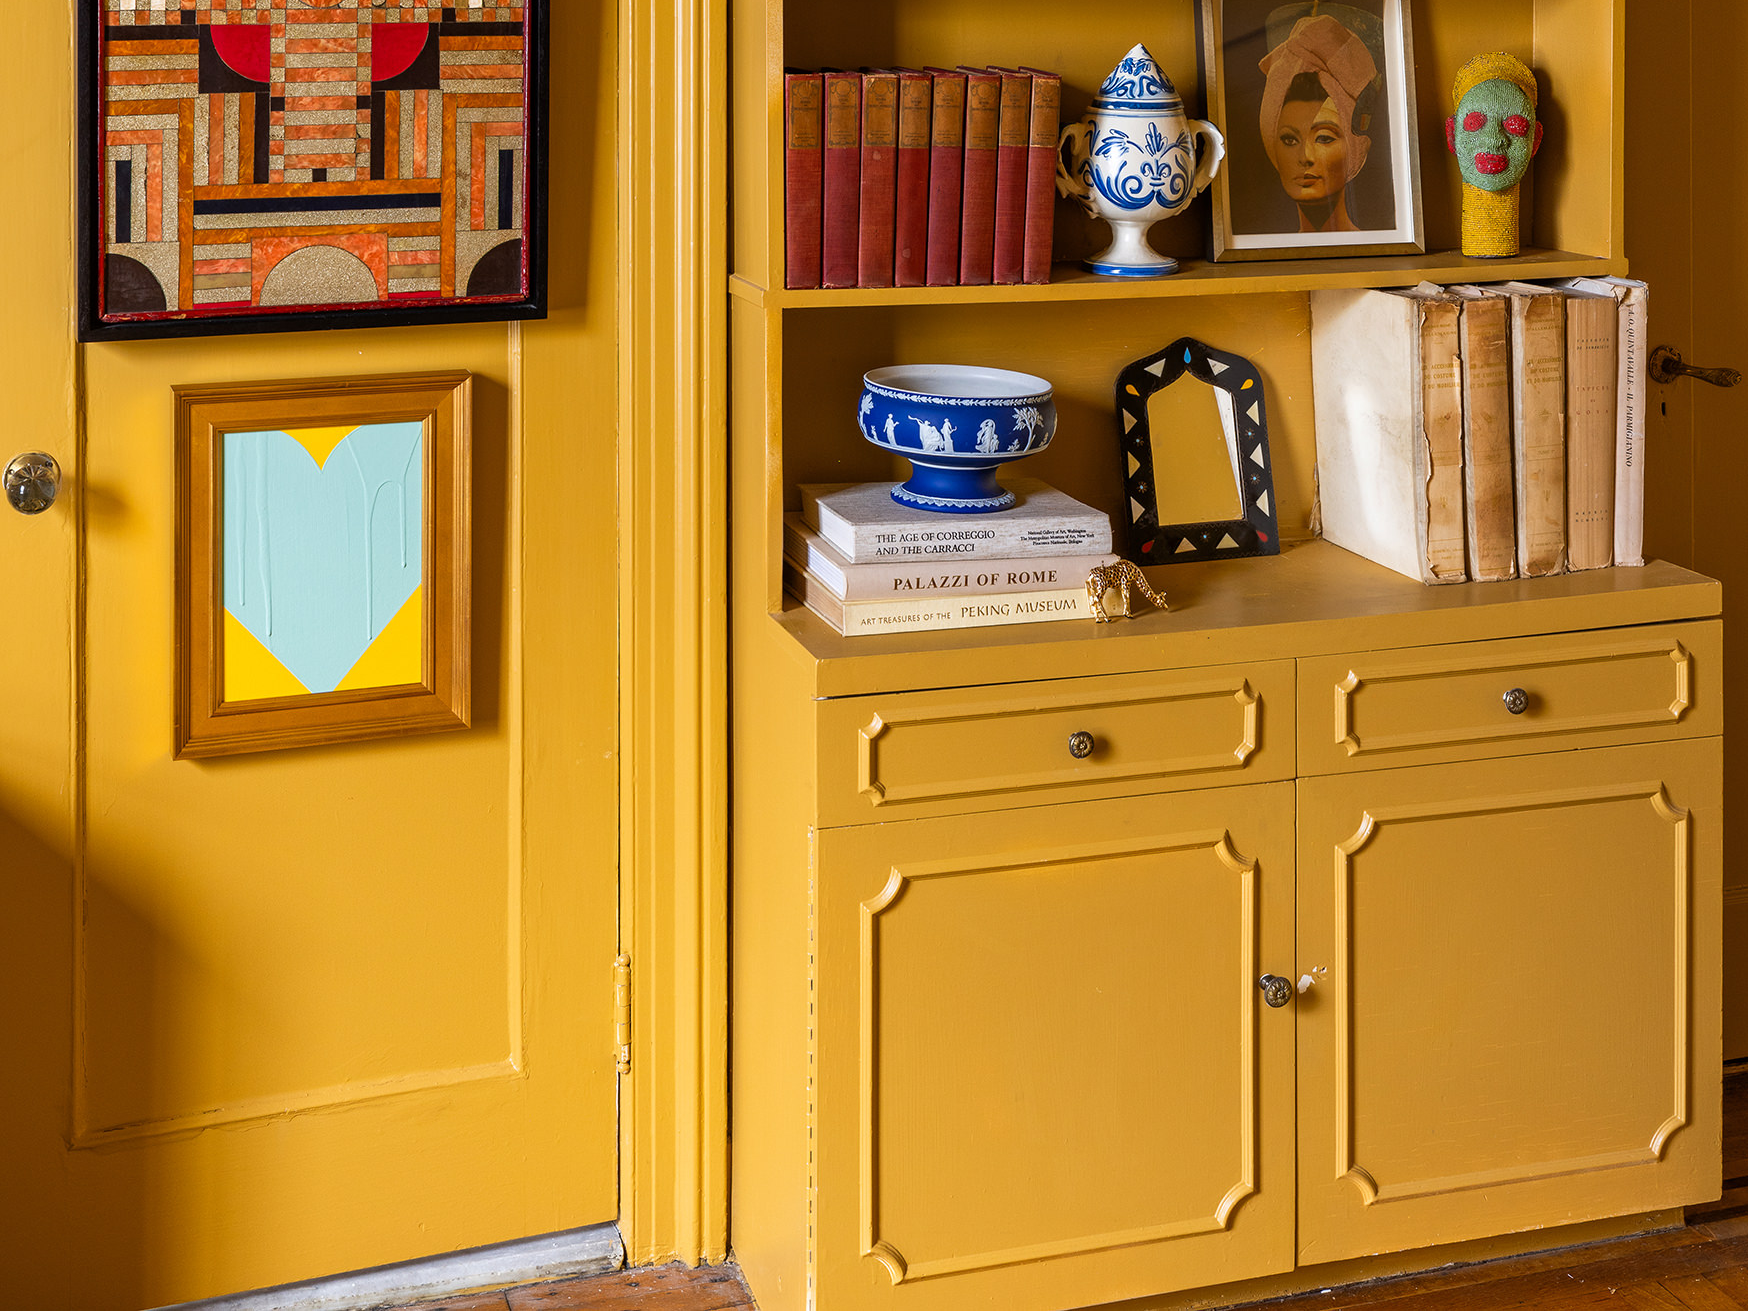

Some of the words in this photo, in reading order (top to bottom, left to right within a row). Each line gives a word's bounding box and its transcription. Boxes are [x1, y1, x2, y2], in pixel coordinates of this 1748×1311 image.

[1240, 143, 1253, 152] The
[1236, 153, 1260, 162] TIGER
[1627, 309, 1635, 318] A.
[1627, 318, 1635, 328] O.
[1626, 328, 1635, 385] QUINTAVALLE
[1626, 392, 1634, 402] IL
[1625, 405, 1634, 468] PARMIGIANINO
[876, 534, 897, 544] THE
[899, 533, 920, 543] AGE
[921, 532, 935, 542] OF
[936, 530, 996, 541] CORREGGIO
[876, 547, 899, 556] AND
[901, 546, 922, 555] THE
[924, 543, 975, 554] CARRACCI
[893, 575, 969, 591] PALAZZI
[977, 573, 1000, 587] OF
[1007, 570, 1058, 585] ROME
[861, 618, 877, 626] ART
[878, 615, 921, 624] TREASURES
[923, 613, 935, 621] OF
[937, 612, 952, 620] THE
[961, 604, 1010, 618] PEKING
[1016, 599, 1077, 614] MUSEUM
